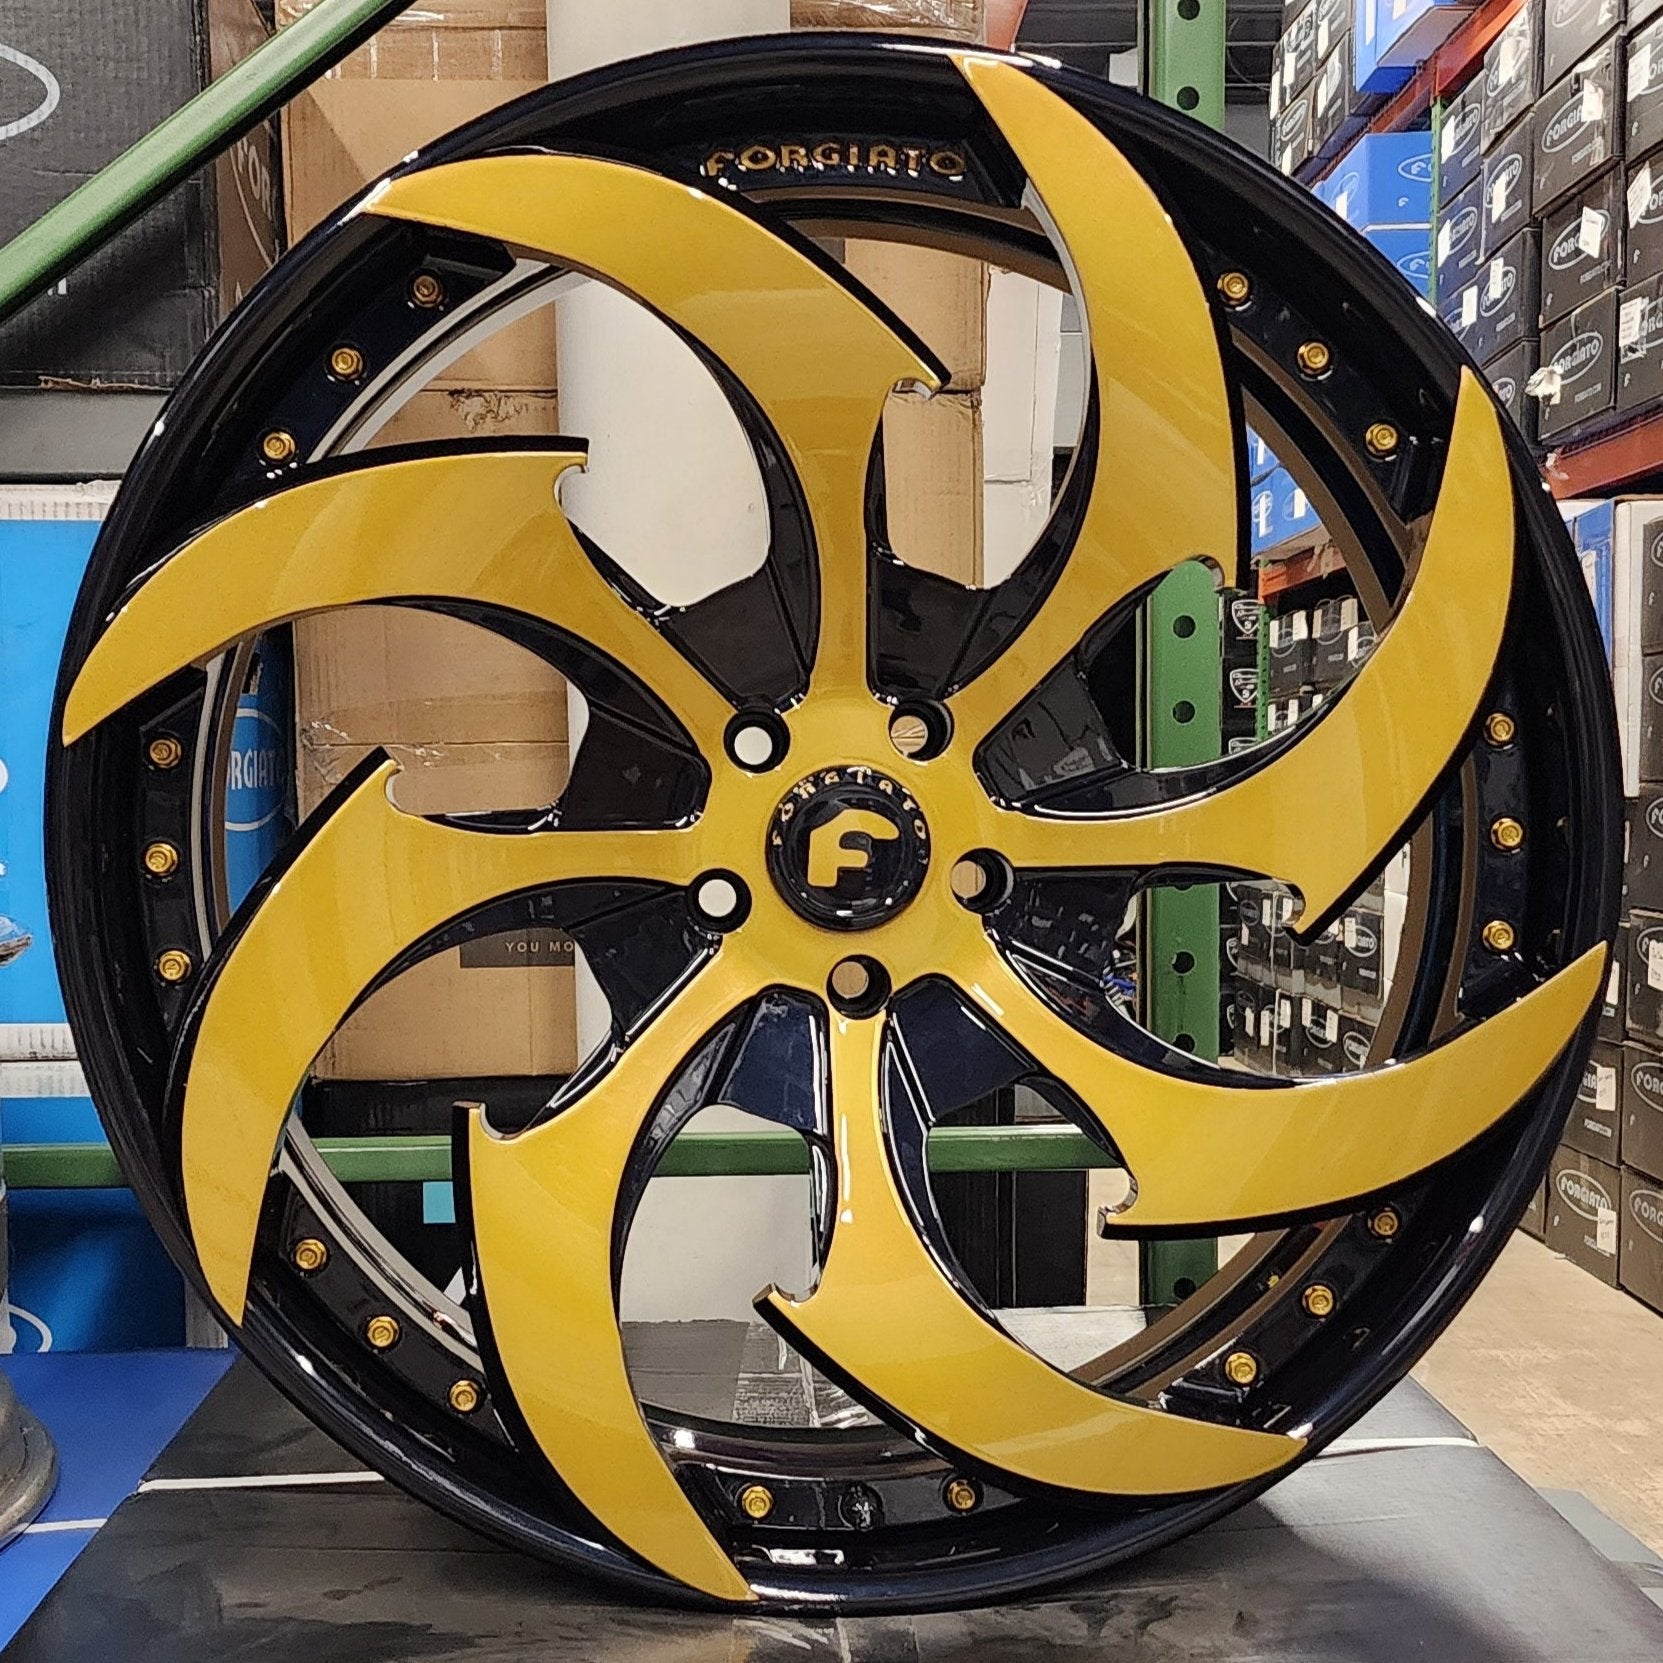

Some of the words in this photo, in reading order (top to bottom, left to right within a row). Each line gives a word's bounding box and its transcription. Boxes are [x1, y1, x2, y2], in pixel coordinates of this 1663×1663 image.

[704, 142, 966, 177] FORGIATO
[505, 942, 540, 953] YOU
[1561, 1176, 1608, 1210] FORGIATO
